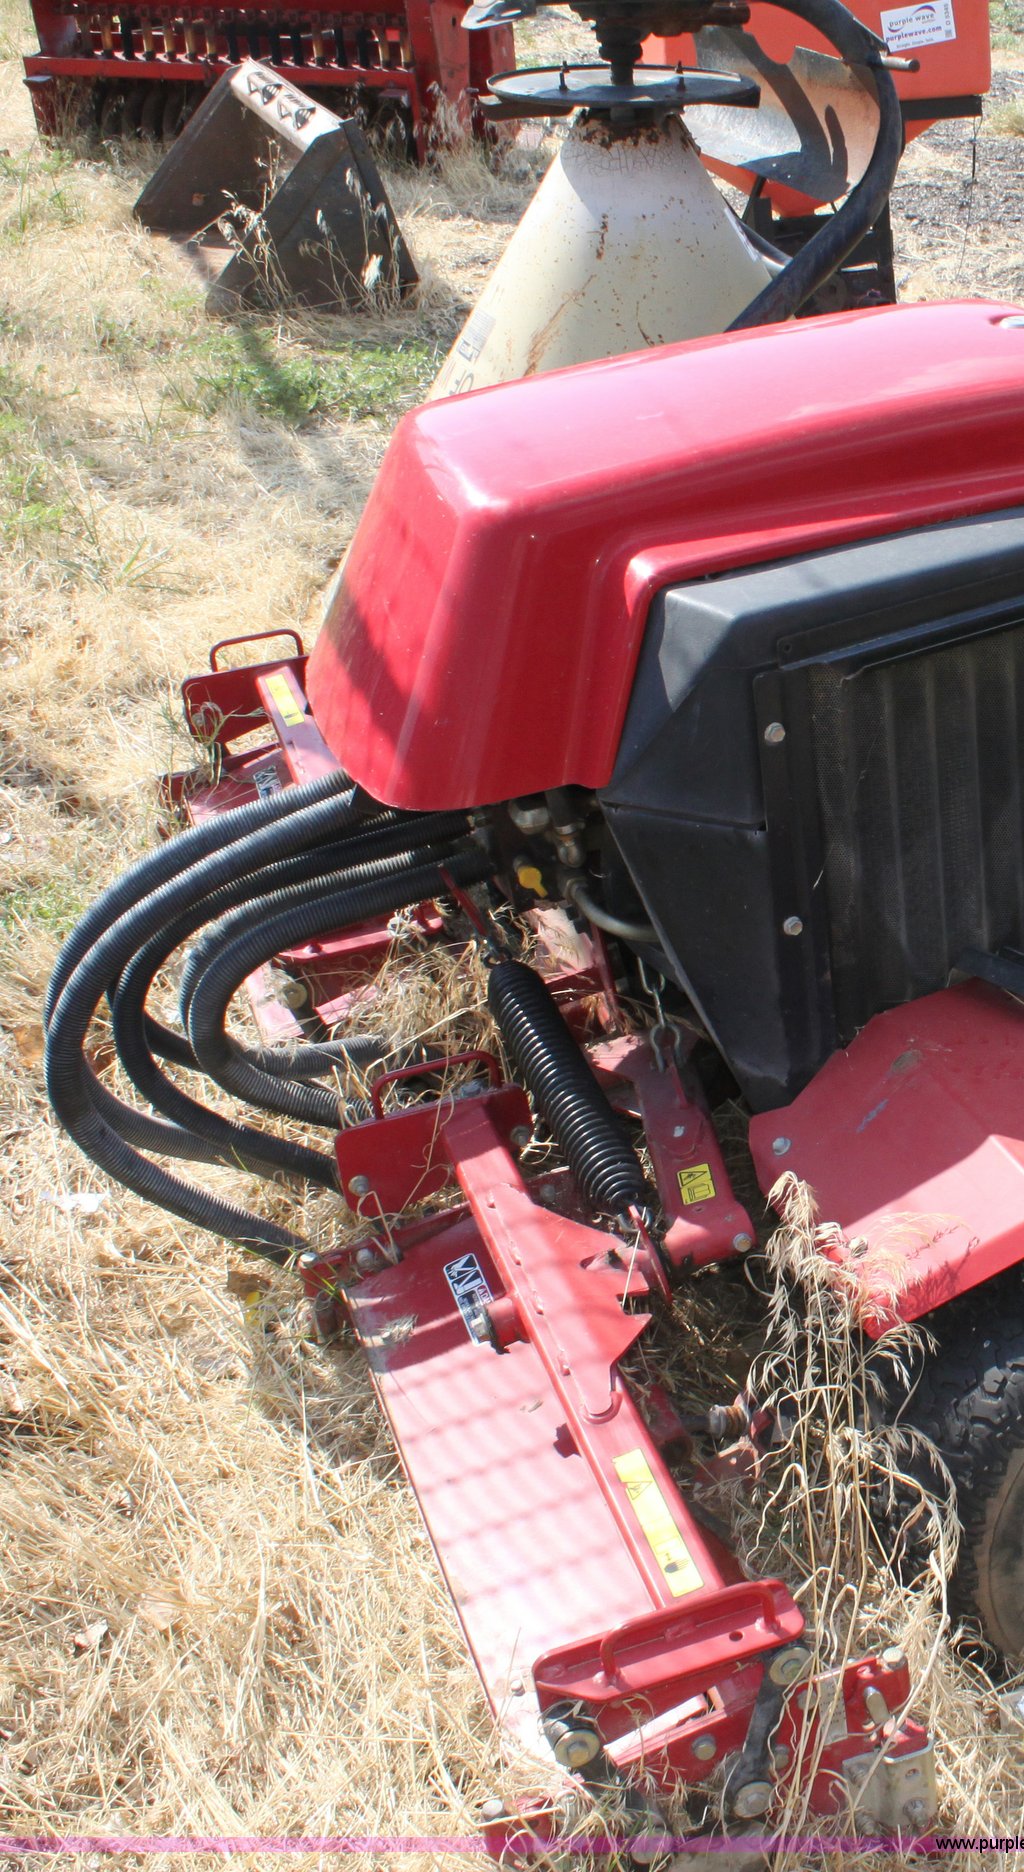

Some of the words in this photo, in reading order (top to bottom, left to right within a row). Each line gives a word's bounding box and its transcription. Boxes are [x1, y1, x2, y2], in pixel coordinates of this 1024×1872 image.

[889, 17, 913, 28] purple
[915, 13, 935, 21] wave
[886, 26, 942, 42] purplewave.com
